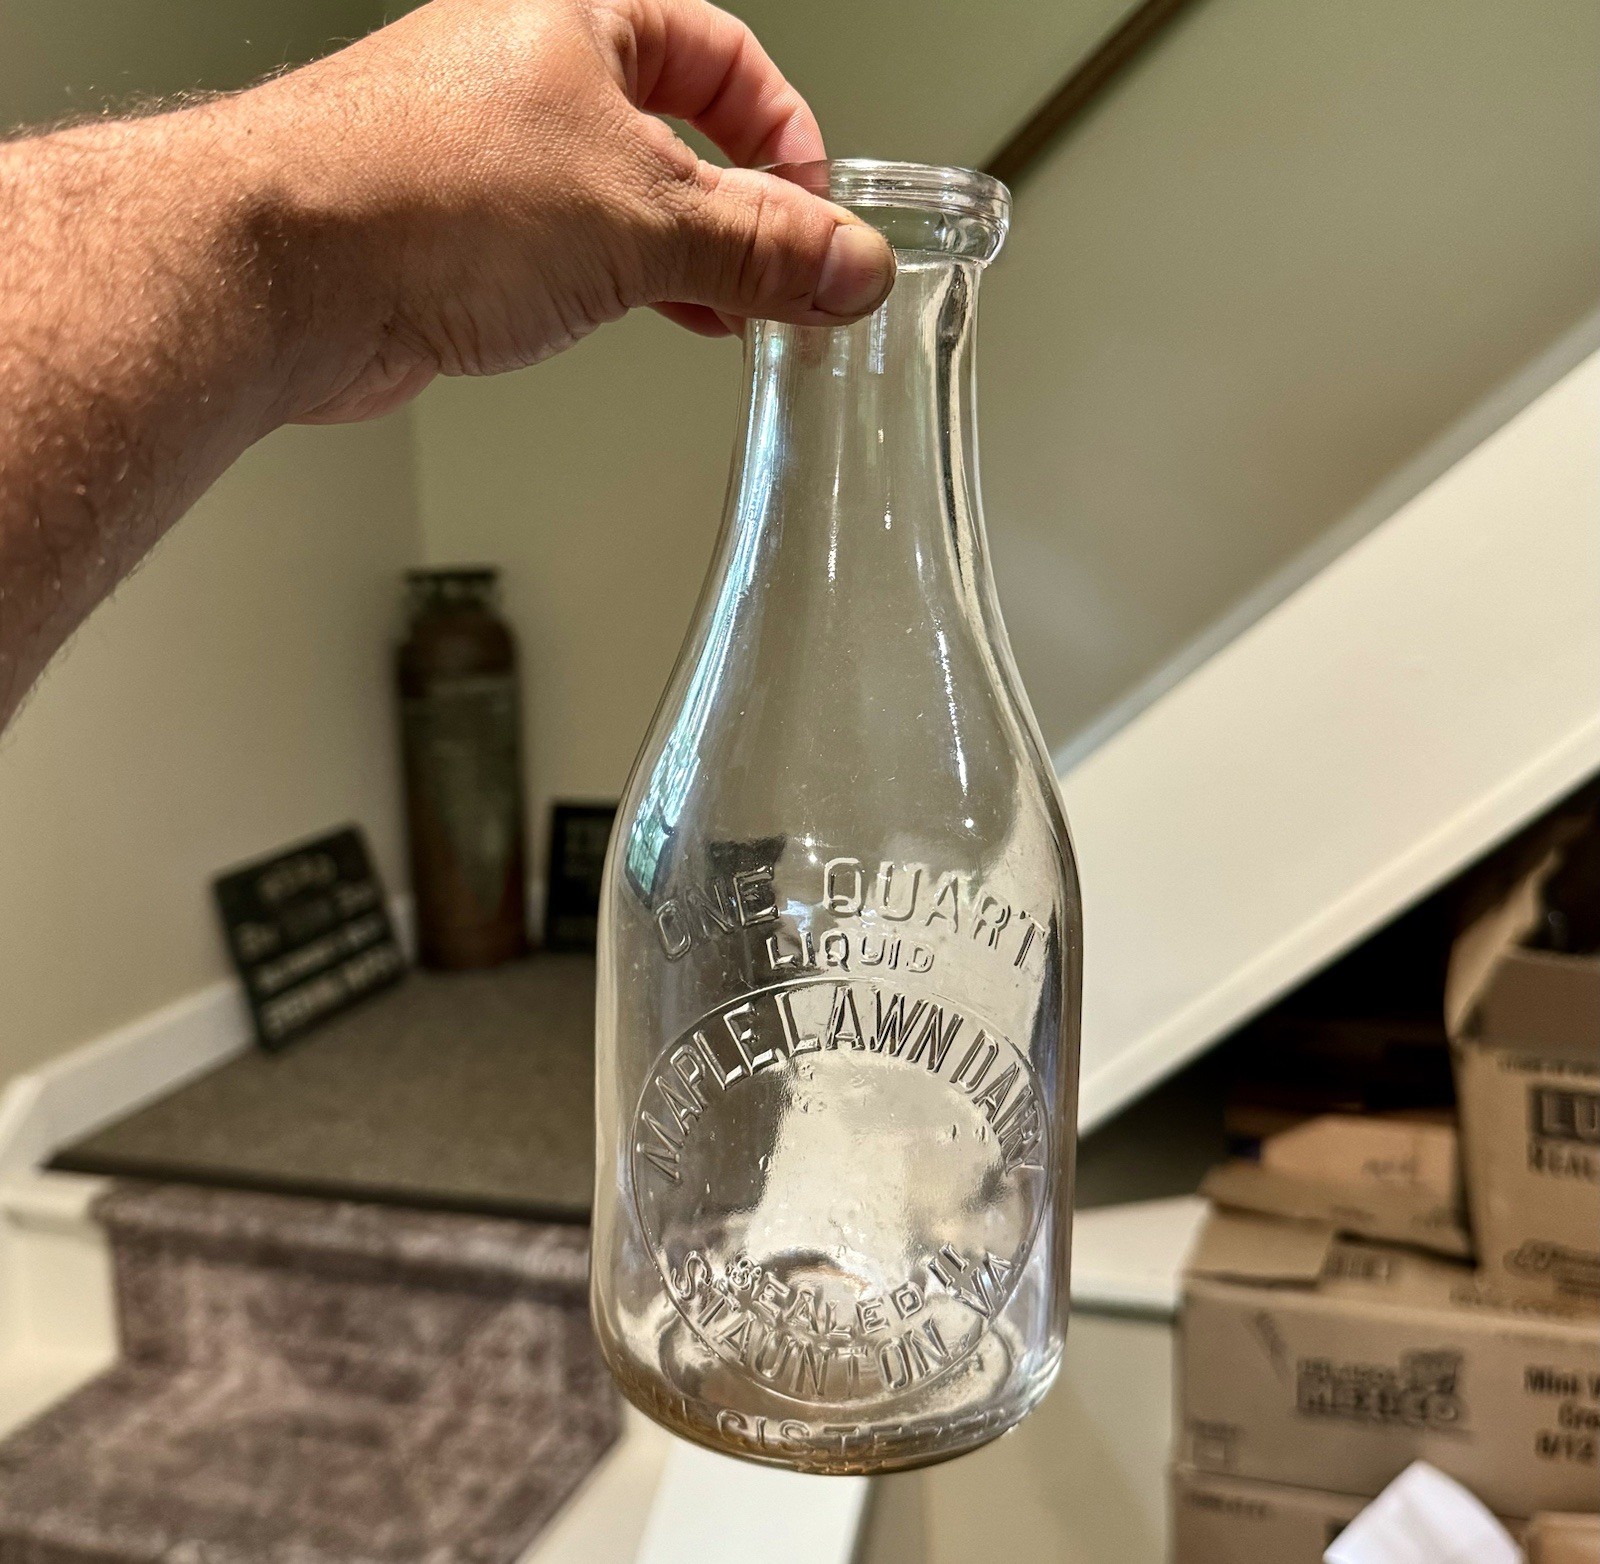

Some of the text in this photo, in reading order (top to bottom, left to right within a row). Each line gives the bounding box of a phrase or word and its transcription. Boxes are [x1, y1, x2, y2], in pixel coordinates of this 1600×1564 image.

[656, 856, 1047, 969] ONE QUART
[764, 929, 936, 974] LIQUID
[636, 985, 1046, 1184] MAPLE LAWN DAIRY
[726, 1251, 924, 1337] SEALED
